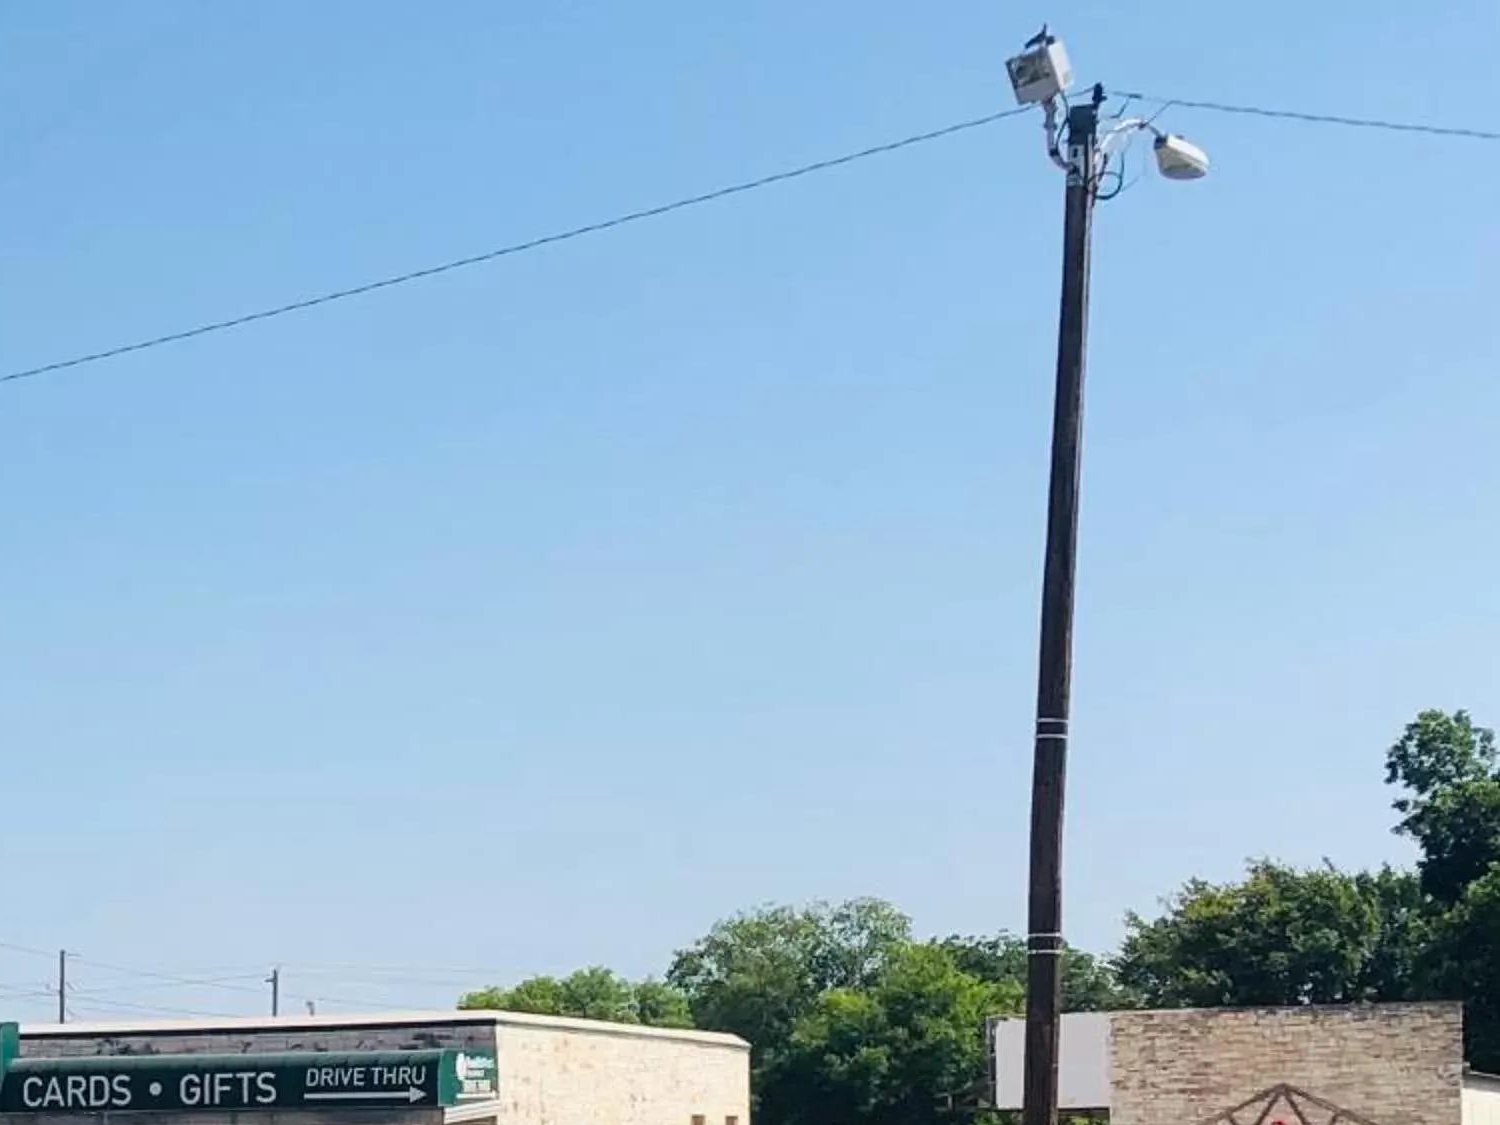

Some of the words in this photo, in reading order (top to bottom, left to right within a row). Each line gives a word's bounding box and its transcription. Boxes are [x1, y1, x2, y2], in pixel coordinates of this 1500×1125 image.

[22, 1074, 132, 1108] CARDS
[180, 1072, 277, 1105] GIFTS
[306, 1067, 366, 1087] DRIVE
[371, 1066, 426, 1086] THRU
